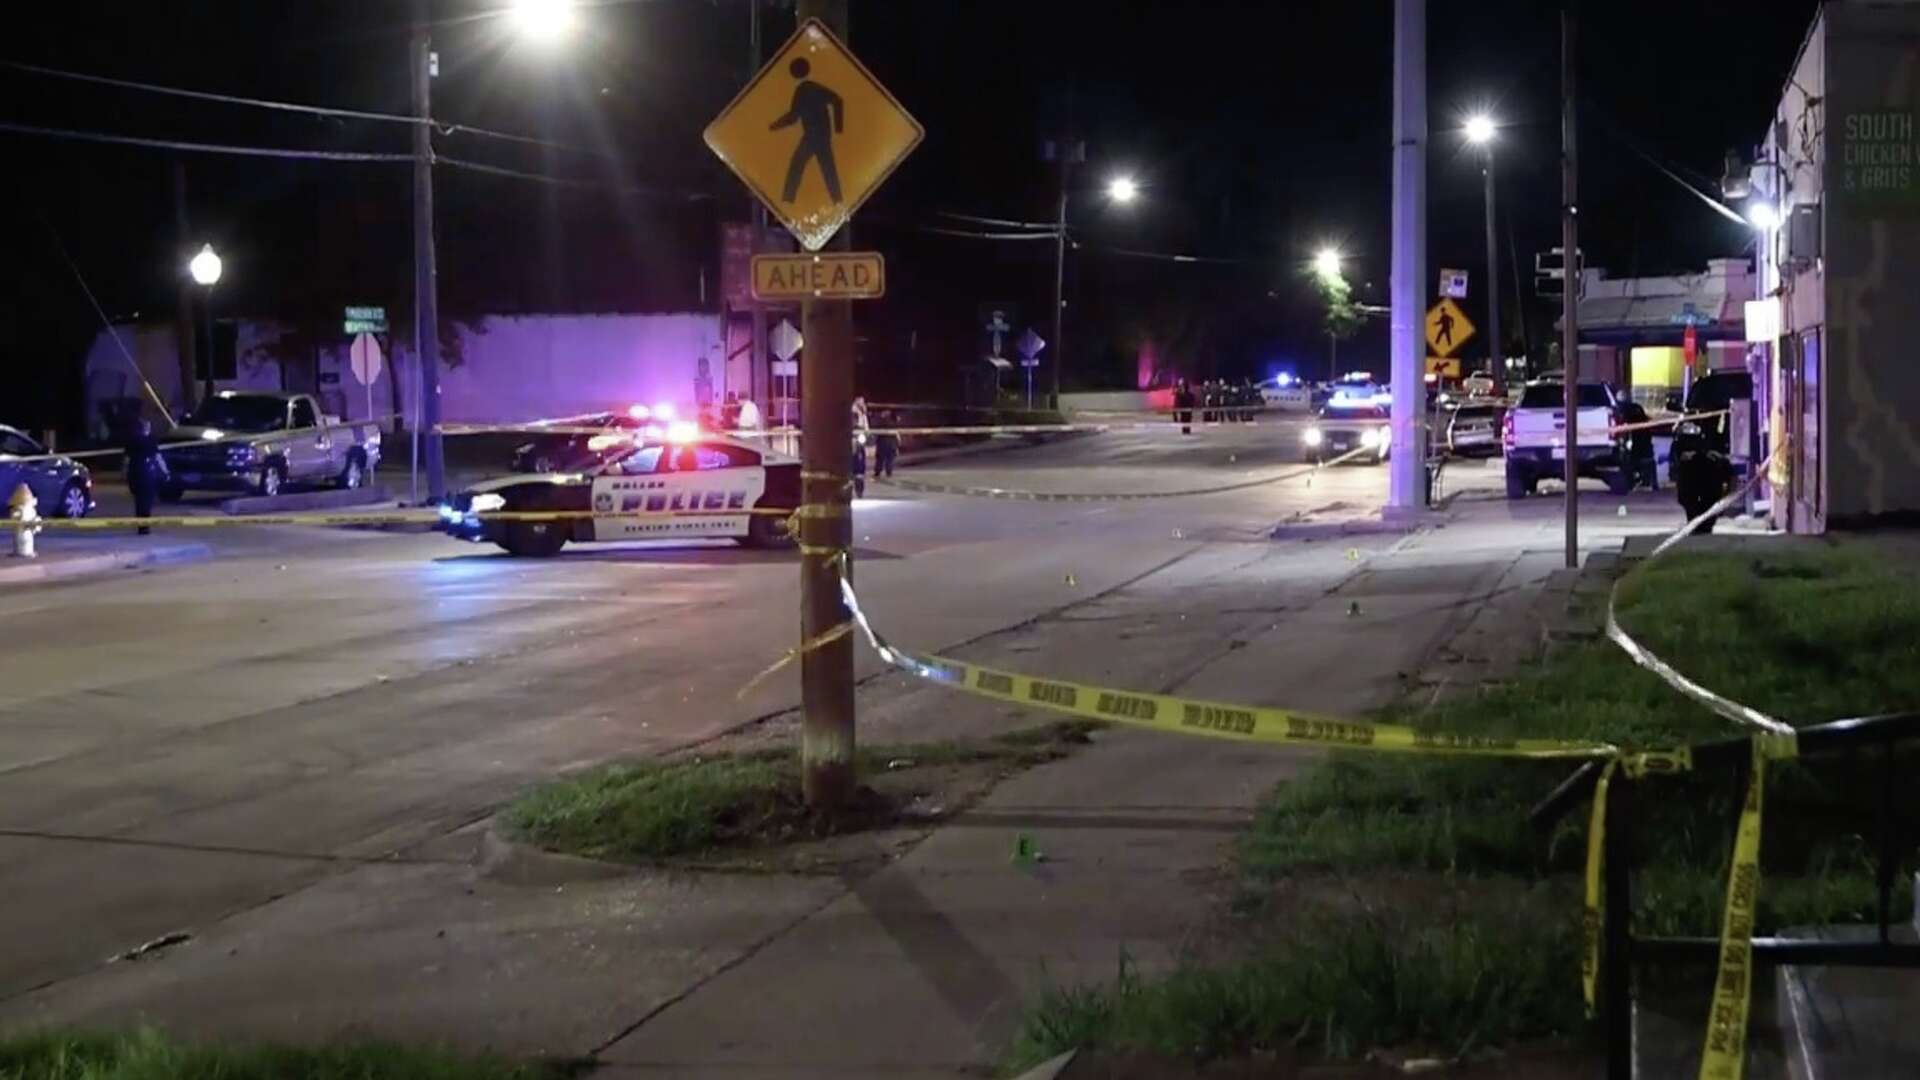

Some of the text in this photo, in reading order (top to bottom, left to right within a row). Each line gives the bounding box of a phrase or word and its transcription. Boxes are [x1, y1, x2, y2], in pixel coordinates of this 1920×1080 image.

[1844, 113, 1912, 140] SOUTH
[1844, 144, 1911, 165] CHICKEN
[1861, 167, 1911, 189] GRITS
[767, 263, 870, 289] AHEAD
[620, 490, 746, 511] POLICE
[1733, 863, 1755, 909] CROSS
